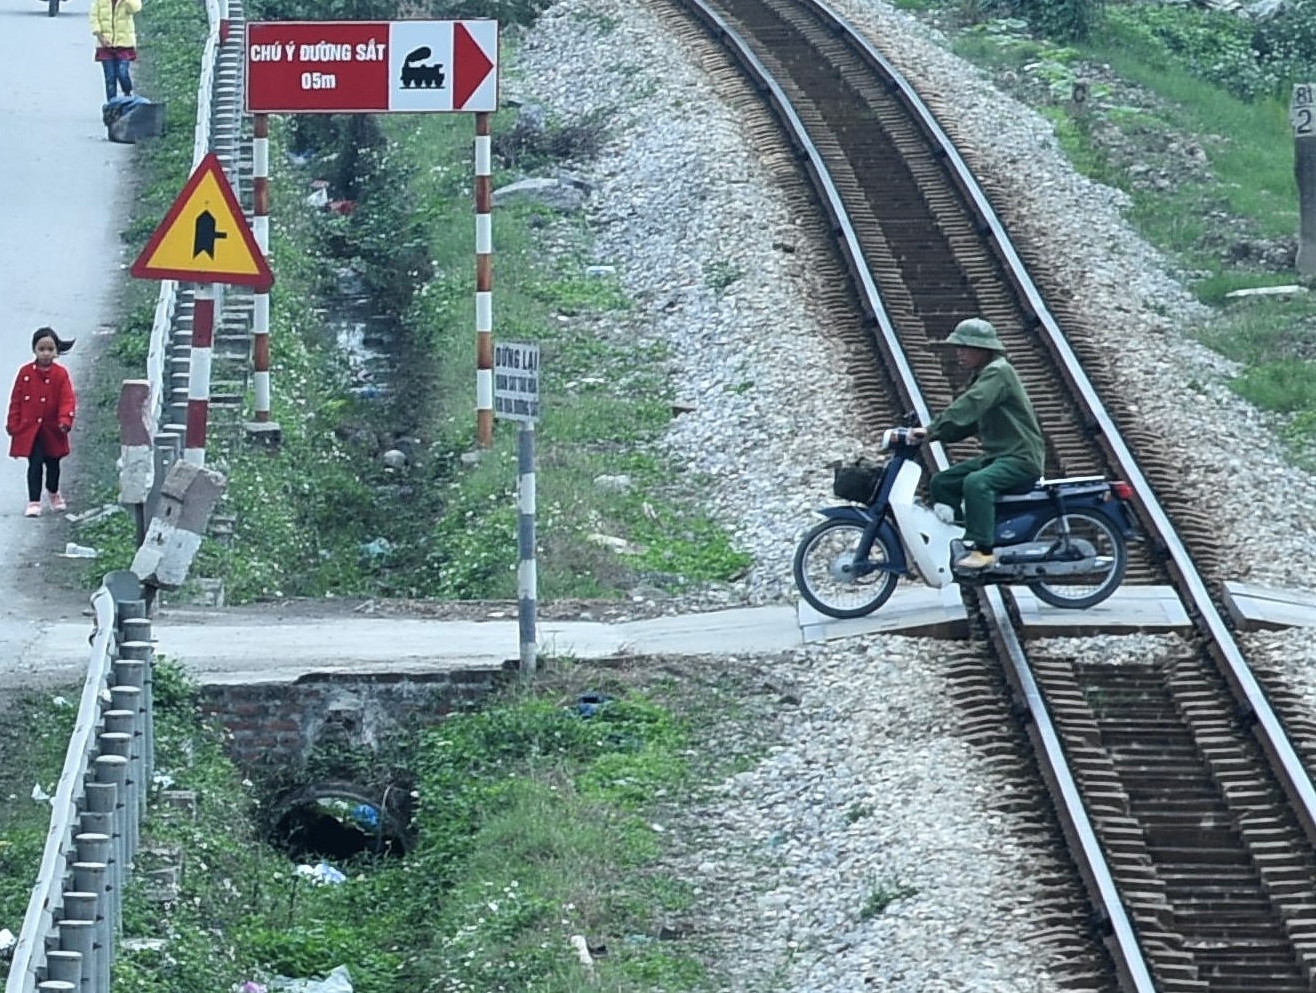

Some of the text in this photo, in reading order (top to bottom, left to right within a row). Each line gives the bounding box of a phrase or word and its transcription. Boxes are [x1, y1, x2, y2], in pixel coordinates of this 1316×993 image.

[250, 37, 386, 62] CHÚ Ý ĐƯỜNG SẮT
[300, 71, 337, 90] 05m
[1296, 86, 1314, 104] 81
[1297, 109, 1312, 134] 2
